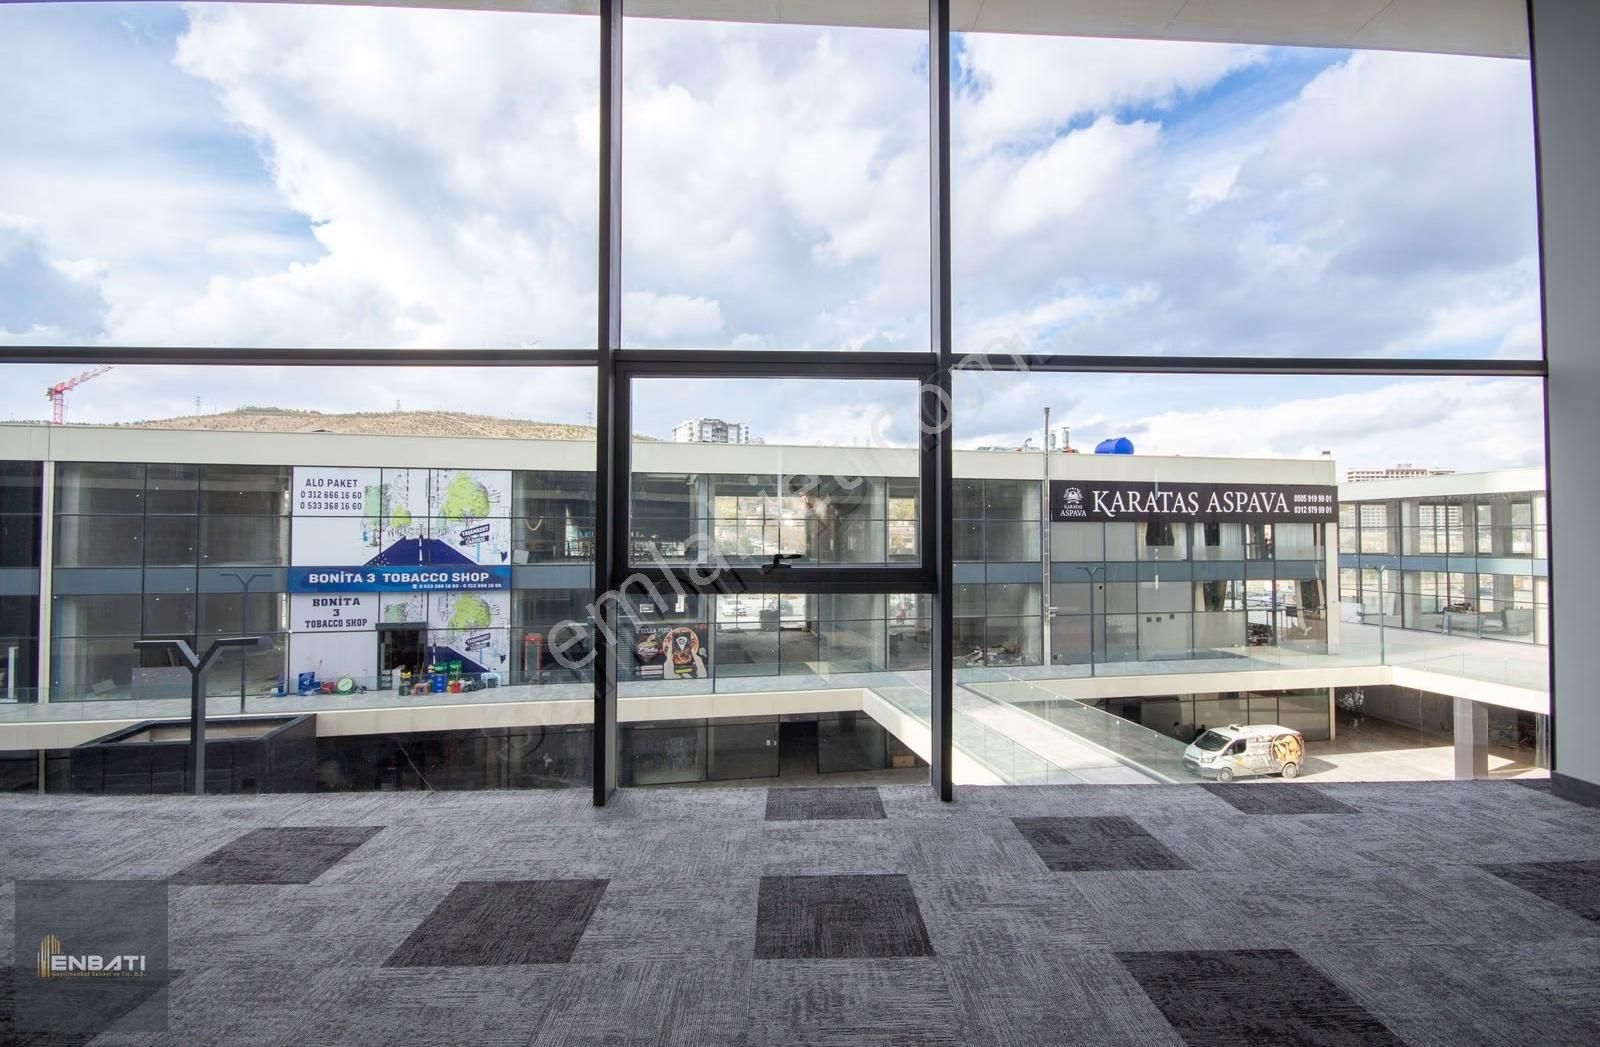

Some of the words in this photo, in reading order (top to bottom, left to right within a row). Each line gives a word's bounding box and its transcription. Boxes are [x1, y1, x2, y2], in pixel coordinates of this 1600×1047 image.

[305, 478, 324, 488] ALO
[327, 478, 358, 488] PAKET
[307, 490, 322, 499] 312
[341, 491, 350, 499] 16
[352, 491, 362, 500] 60
[300, 501, 305, 510] 0
[307, 501, 322, 510] 533
[341, 502, 350, 510] 16
[352, 502, 362, 510] 60
[1091, 490, 1199, 518] KARATAŞ
[1205, 491, 1290, 513] ASPAVA
[1060, 509, 1087, 517] ASPAVA
[308, 571, 363, 584] BONİTA
[366, 573, 376, 583] 3
[382, 573, 448, 583] TOBACCO
[451, 572, 489, 582] SHOP
[312, 596, 361, 607] BONİTA
[333, 608, 340, 617] 3
[305, 619, 343, 629] TOBACCO
[346, 618, 367, 628] SHOP
